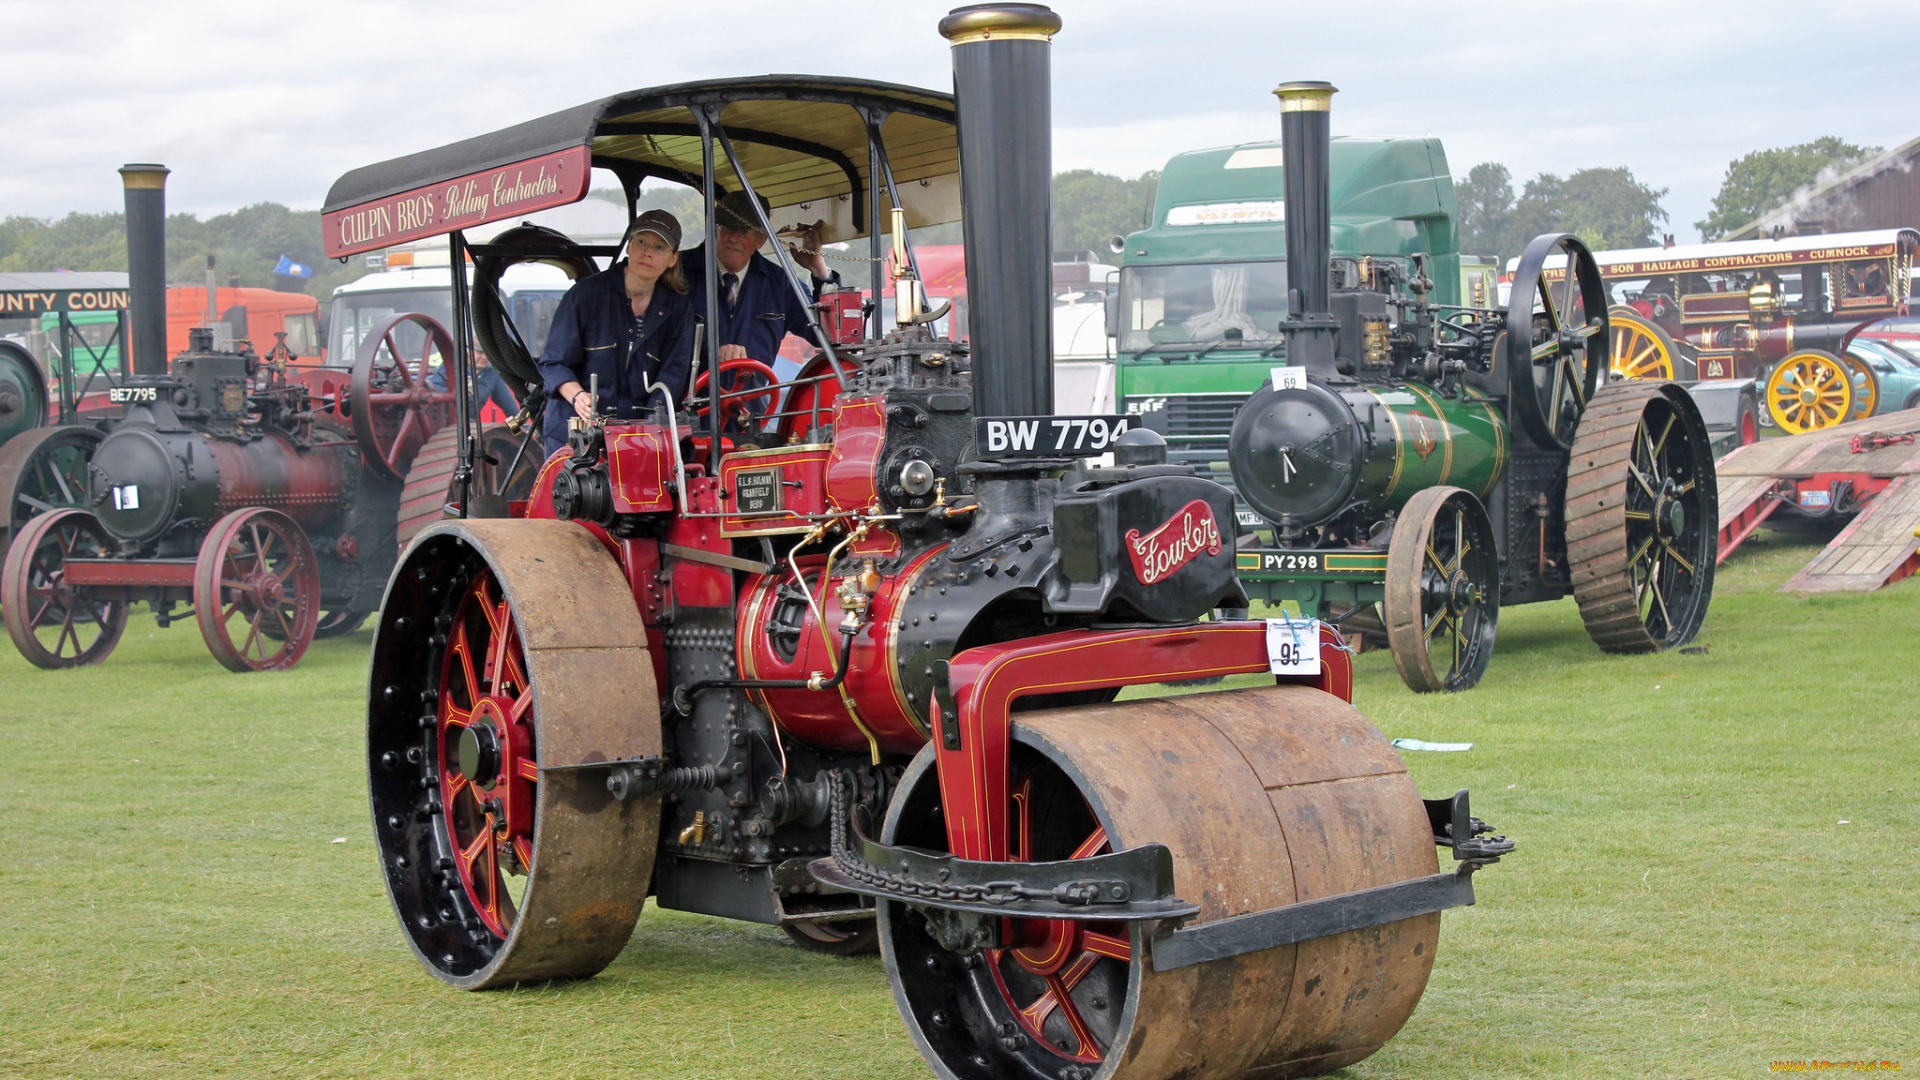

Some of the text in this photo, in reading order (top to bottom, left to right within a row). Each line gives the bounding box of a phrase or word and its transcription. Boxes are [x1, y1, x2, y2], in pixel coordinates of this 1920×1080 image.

[341, 205, 391, 246] CULPIN
[443, 180, 489, 220] Rolling
[491, 165, 557, 208] Contractors
[1543, 269, 1567, 279] FRE
[1611, 264, 1634, 274] SON
[1642, 259, 1699, 272] HAULAGE
[1705, 252, 1793, 267] CONTRACTORS
[1809, 247, 1869, 259] CUMNOCK
[67, 291, 130, 310] COUN
[1284, 377, 1296, 389] 69
[110, 388, 157, 402] BE7795
[1127, 402, 1164, 412] ERF
[987, 418, 1128, 452] BW 7794
[1136, 512, 1217, 583] Fowler
[1265, 555, 1318, 569] PY298
[1280, 643, 1300, 666] 95
